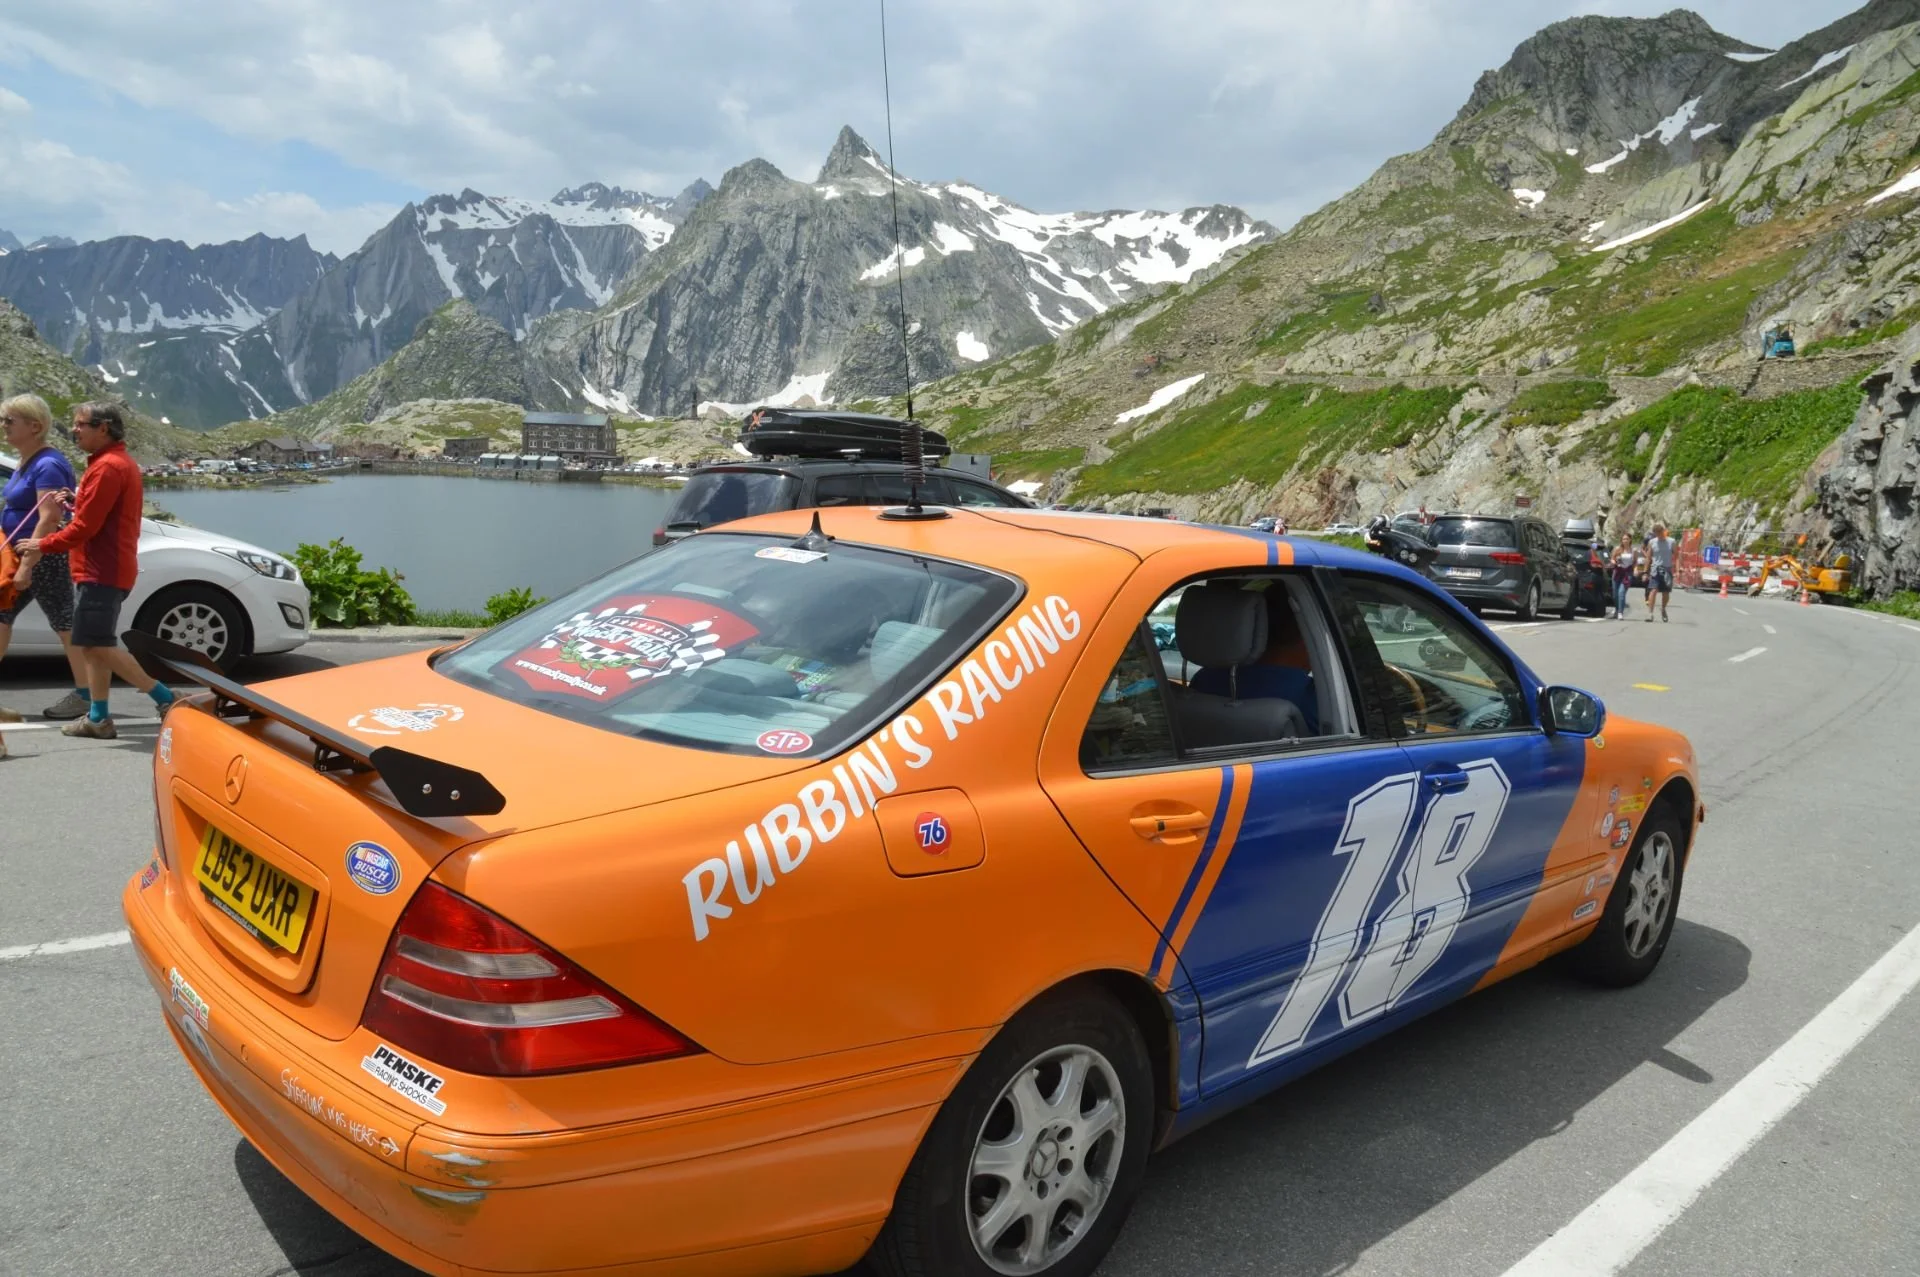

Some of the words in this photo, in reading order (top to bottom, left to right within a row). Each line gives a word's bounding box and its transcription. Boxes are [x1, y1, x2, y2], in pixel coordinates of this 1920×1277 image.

[763, 732, 804, 749] STP
[682, 714, 933, 941] RUBBIN'S
[926, 595, 1081, 740] RACING
[919, 817, 947, 847] 76
[201, 828, 254, 903] LB52
[250, 863, 299, 937] UXR
[354, 860, 390, 881] BUSCH
[1246, 757, 1511, 1069] 18
[373, 1046, 442, 1094] PENSKE
[374, 1066, 398, 1088] RACING
[397, 1081, 428, 1105] SHOCKS
[327, 1106, 347, 1128] WAS
[349, 1120, 378, 1147] HERE
